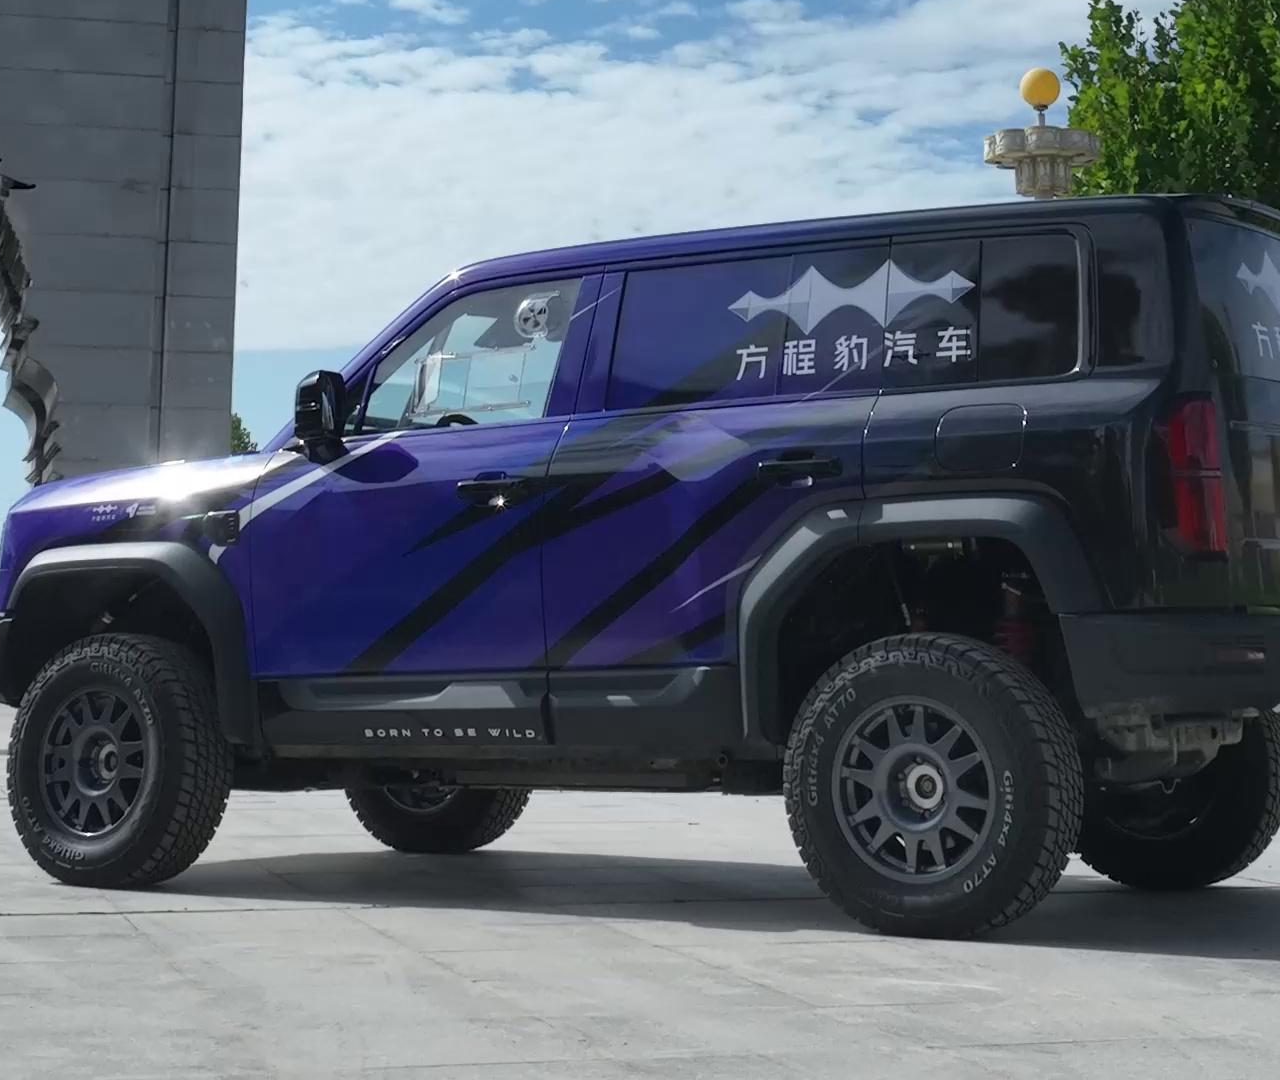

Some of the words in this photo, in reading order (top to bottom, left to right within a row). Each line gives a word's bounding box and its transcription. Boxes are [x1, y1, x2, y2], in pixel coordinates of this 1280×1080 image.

[736, 327, 972, 381] 方程豹汽车
[824, 688, 856, 728] AT70
[364, 728, 412, 738] BORN
[422, 728, 444, 737] TO
[454, 728, 477, 737] BE
[488, 728, 536, 738] WILD
[963, 854, 997, 893] AT70
